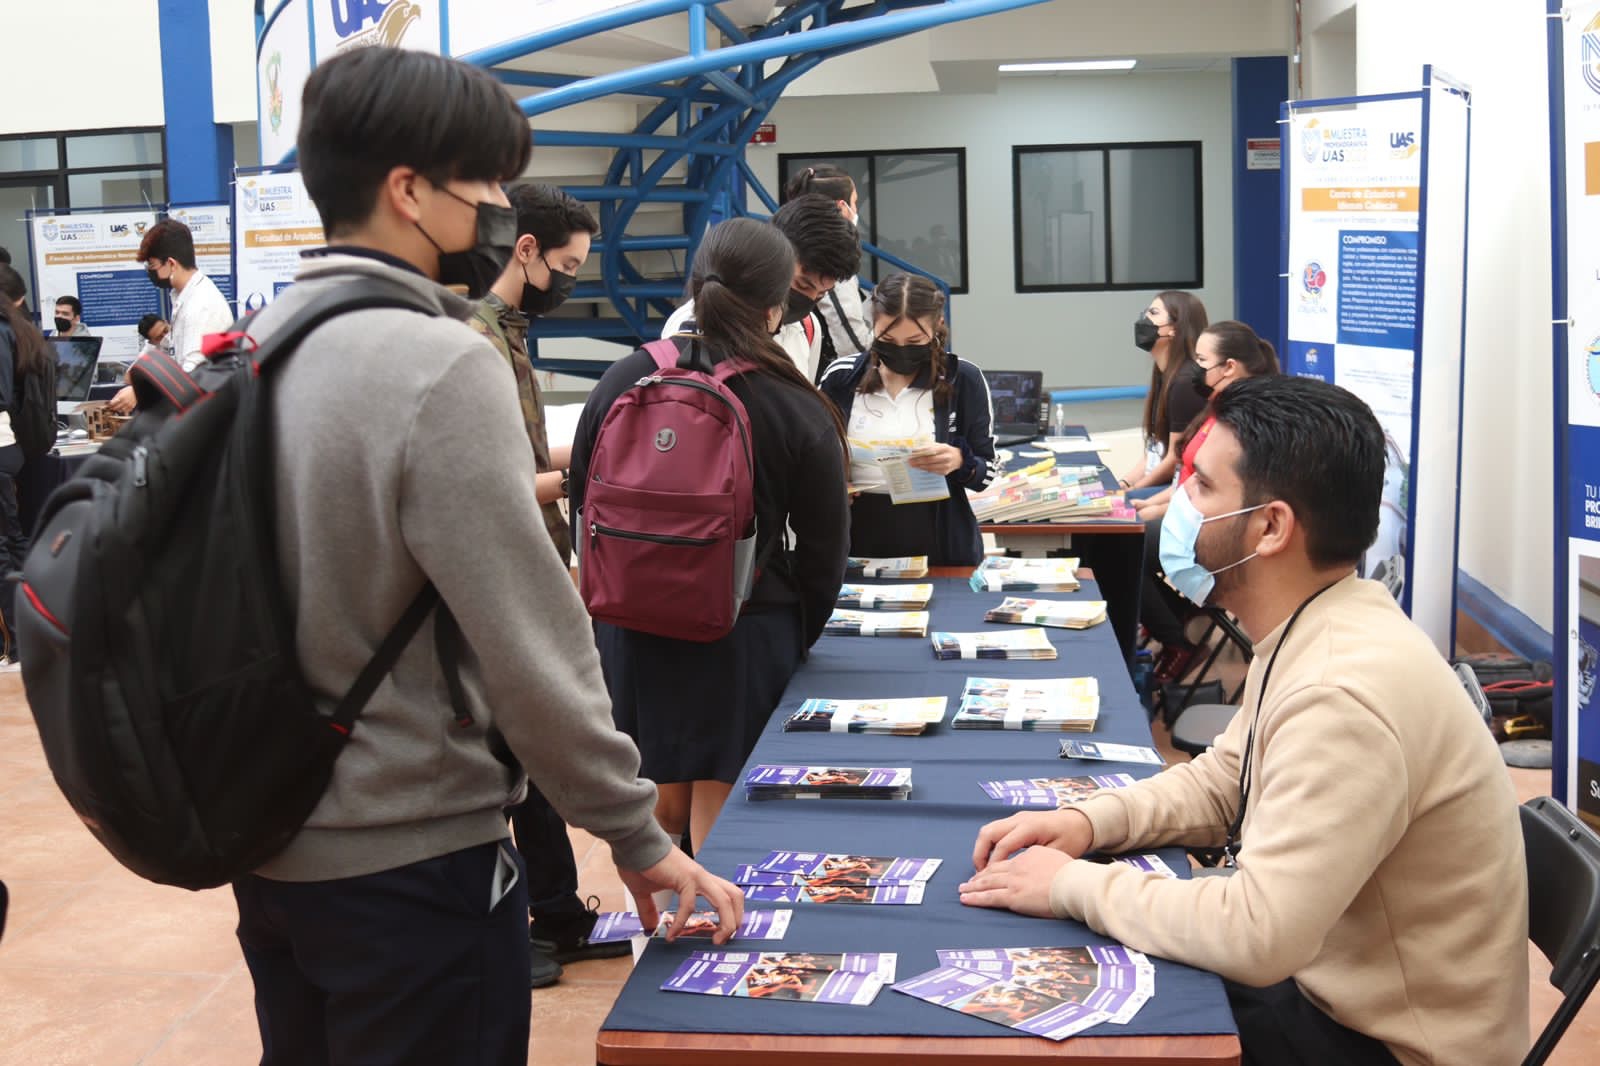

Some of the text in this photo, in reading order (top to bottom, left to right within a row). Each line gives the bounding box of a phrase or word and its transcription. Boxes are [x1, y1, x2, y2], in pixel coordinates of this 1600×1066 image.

[1390, 131, 1415, 149] UAS
[1322, 149, 1345, 162] UAS
[259, 202, 276, 212] UAS
[110, 224, 128, 233] UAS
[1585, 483, 1597, 498] TU
